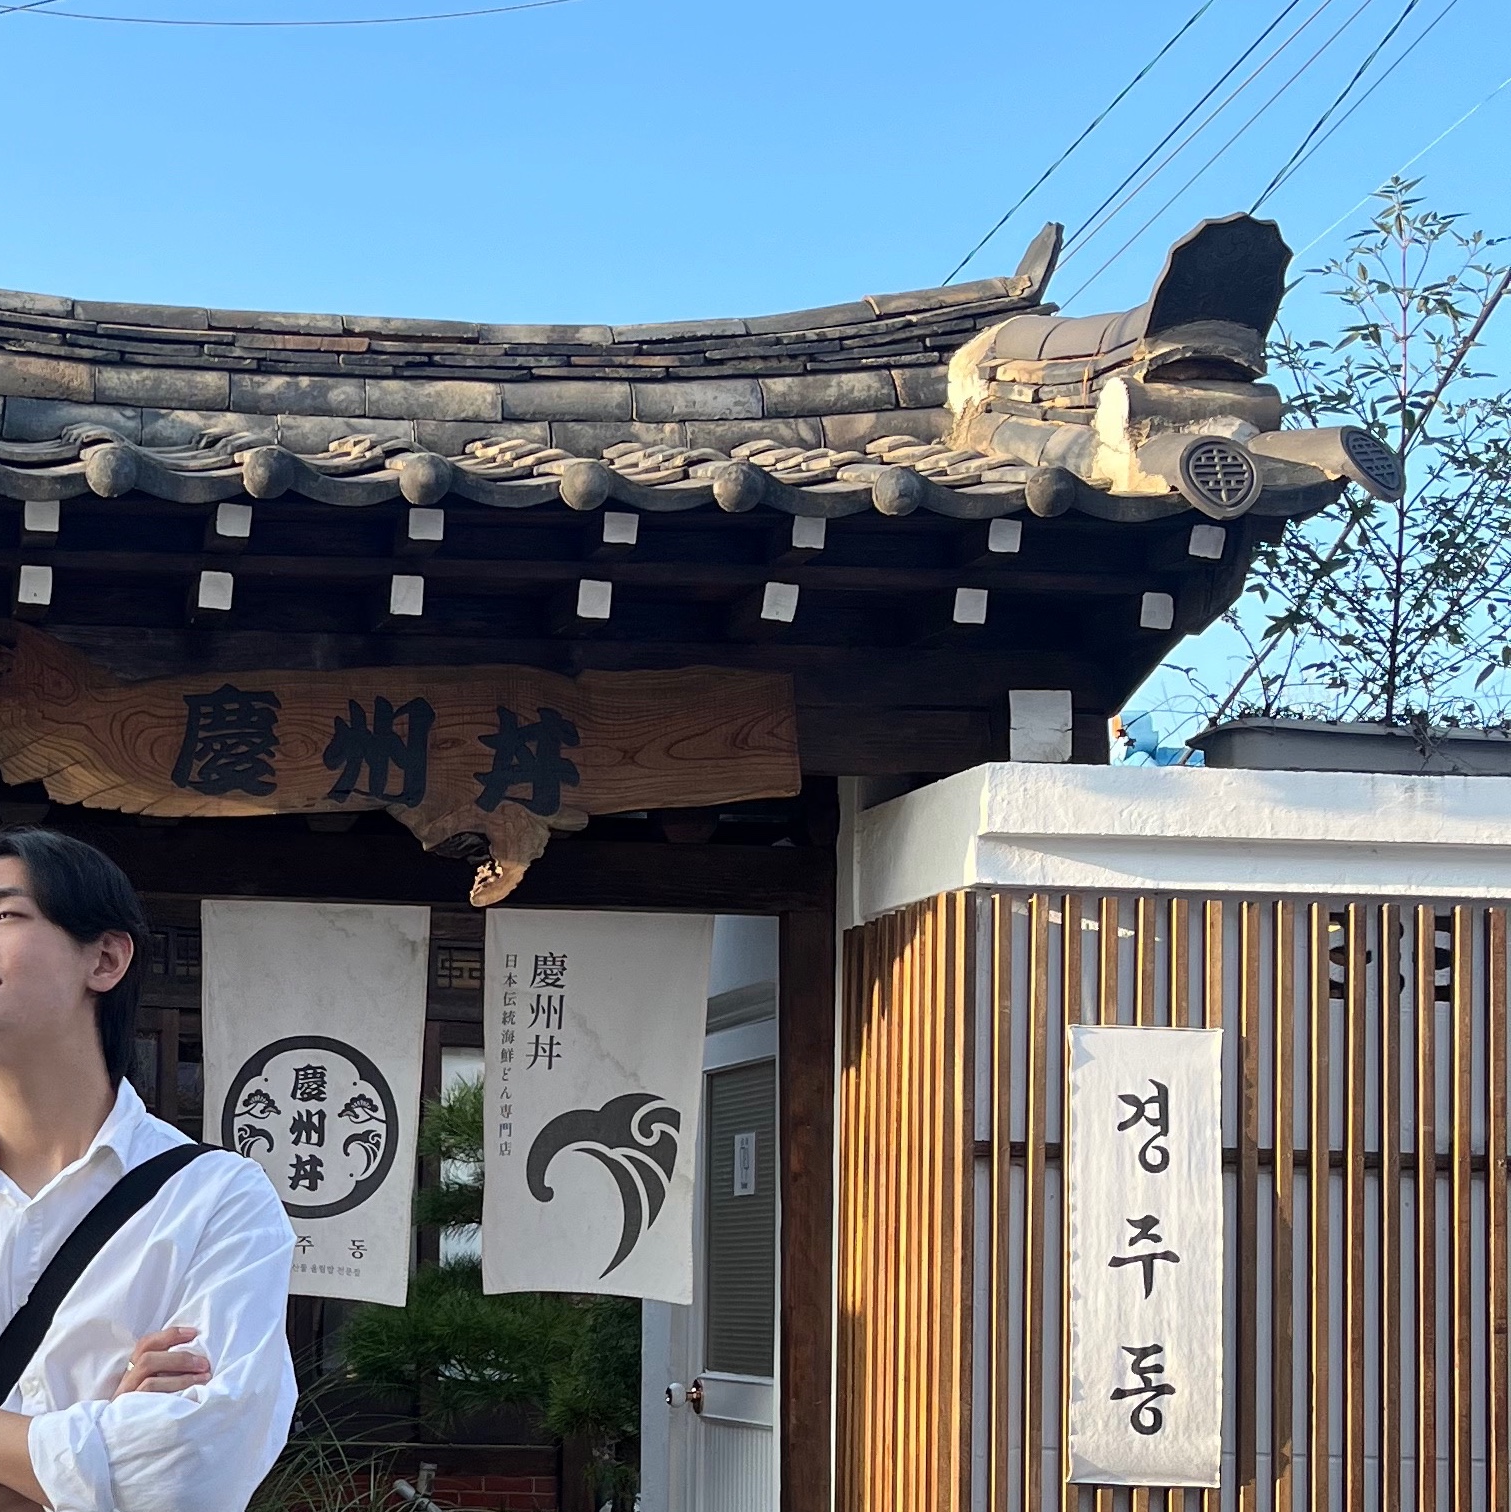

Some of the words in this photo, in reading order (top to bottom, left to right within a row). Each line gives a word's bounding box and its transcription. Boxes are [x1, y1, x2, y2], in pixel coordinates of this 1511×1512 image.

[171, 684, 582, 817] 慶州丼
[498, 953, 518, 1157] 日本伝統海鮮どん専門店
[525, 951, 569, 1071] 慶州丼
[288, 1063, 328, 1192] 慶州丼
[1108, 1078, 1181, 1436] 경주동
